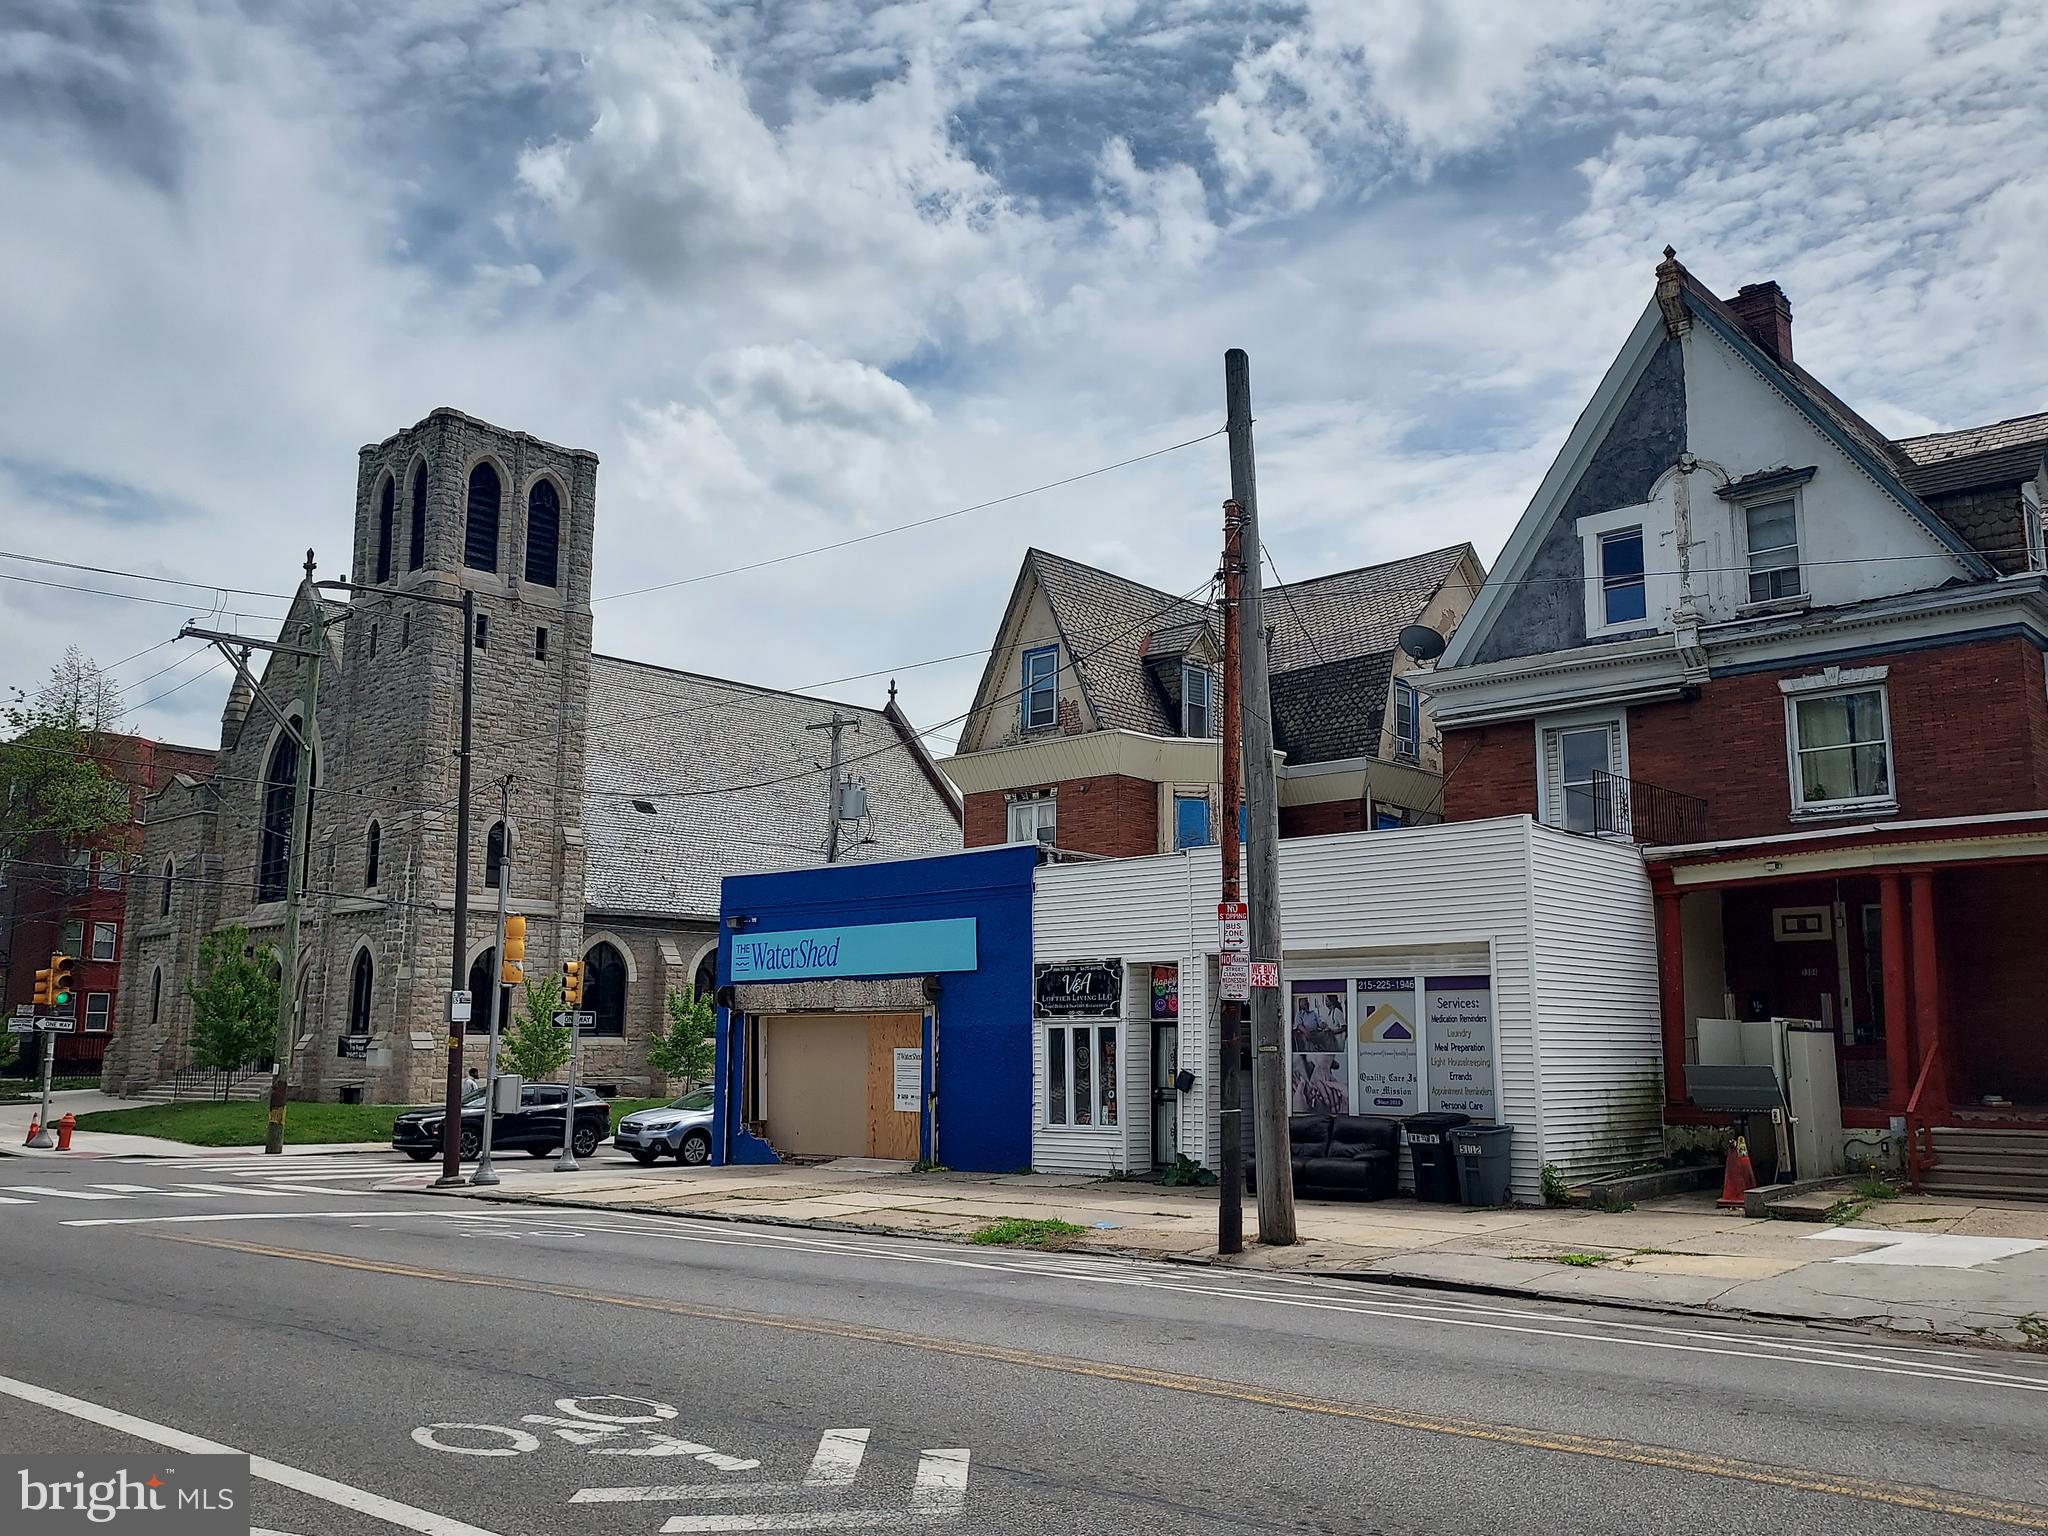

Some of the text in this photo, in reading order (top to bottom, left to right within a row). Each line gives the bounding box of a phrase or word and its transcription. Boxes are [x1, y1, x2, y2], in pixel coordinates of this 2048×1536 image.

[1227, 904, 1238, 913] NO
[1225, 922, 1241, 930] BUS
[736, 936, 840, 971] THE WaterShed
[1221, 954, 1231, 964] NO
[1251, 964, 1277, 975] WE BUY
[1062, 972, 1092, 994] V&A
[1152, 976, 1177, 987] Happy
[1358, 980, 1415, 990] 215-225-1946
[1097, 993, 1113, 1001] LLC
[1437, 997, 1480, 1009] Services:
[1431, 1014, 1488, 1023] Medication Reminders
[1447, 1029, 1472, 1039] Laundry
[1434, 1042, 1486, 1053] Meal Preparation
[1431, 1057, 1491, 1067] Light Housekeeping
[1360, 1072, 1417, 1083] Quality Care Is
[1449, 1071, 1473, 1081] Errands
[1365, 1085, 1412, 1095] Our Mission
[1431, 1086, 1493, 1096] Appointment Reminders
[1440, 1100, 1484, 1110] Personal Care
